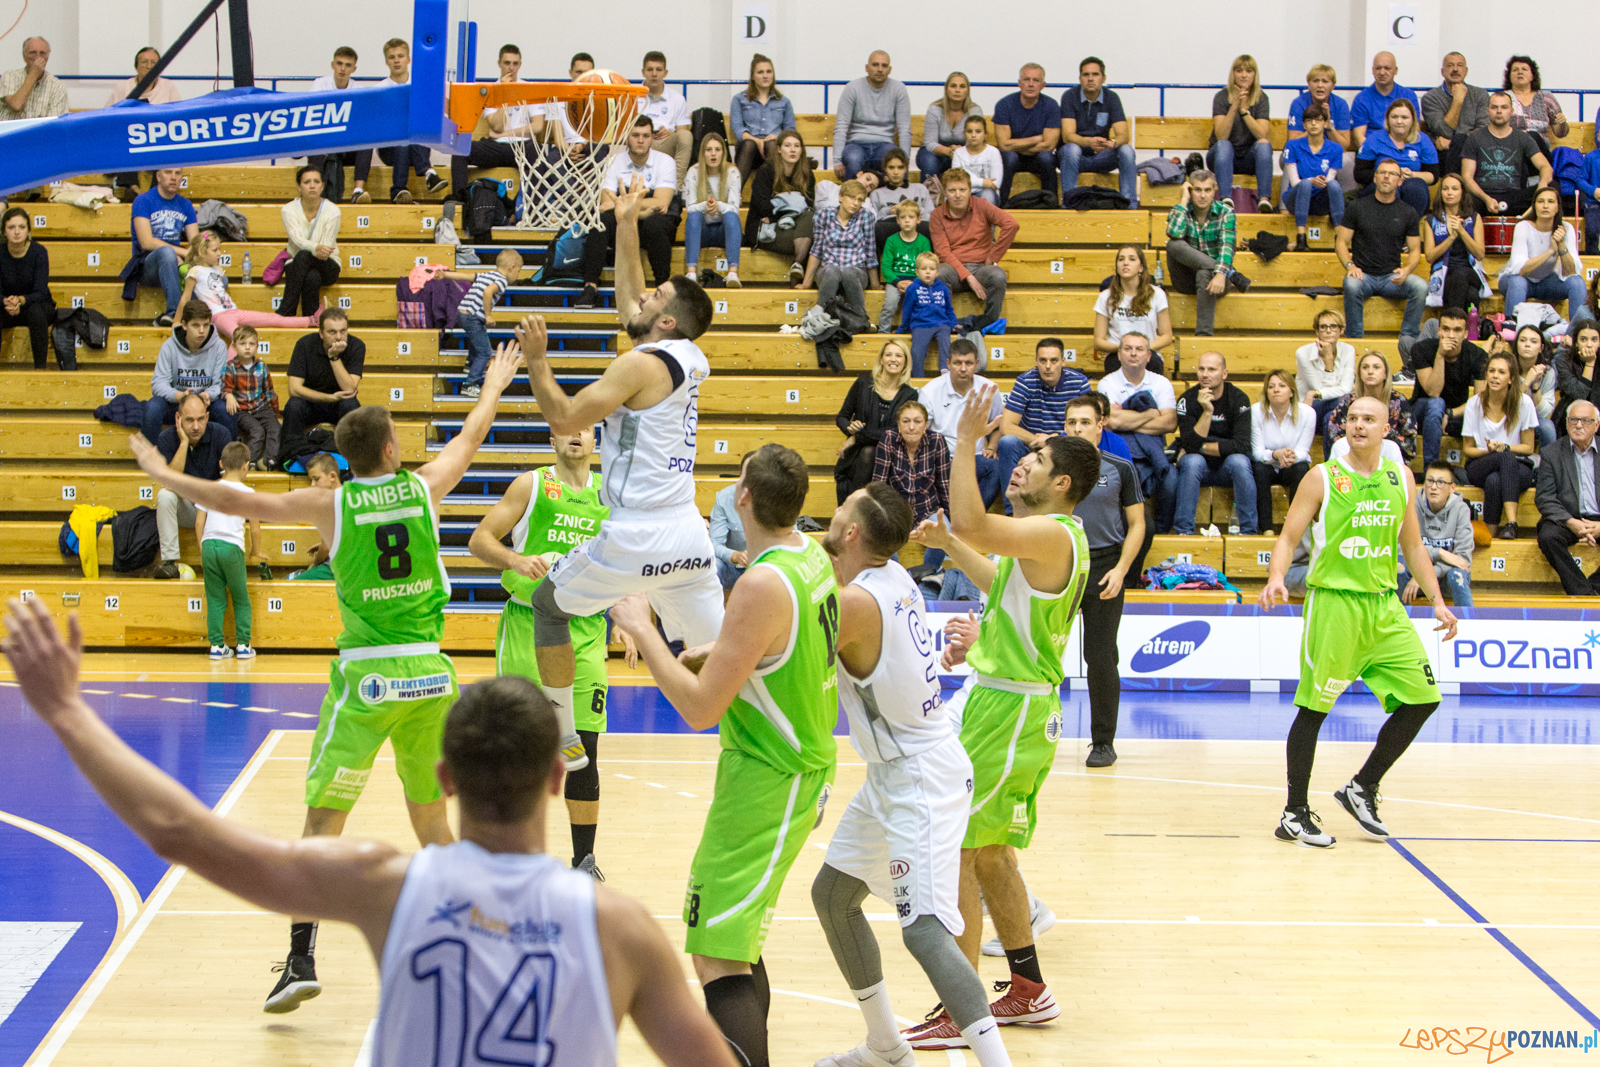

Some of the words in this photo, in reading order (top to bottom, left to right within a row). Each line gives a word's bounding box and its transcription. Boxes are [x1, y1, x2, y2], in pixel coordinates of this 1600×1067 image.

[745, 15, 766, 39] D
[1392, 15, 1414, 40] C
[127, 115, 228, 145] SPORT
[230, 100, 353, 141] SYSTEM
[359, 218, 368, 226] 10
[1310, 229, 1319, 237] 14
[1054, 263, 1060, 271] 2
[340, 299, 350, 307] 10
[719, 303, 724, 311] 7
[789, 303, 794, 311] 6
[260, 343, 268, 351] 11
[402, 344, 407, 352] 9
[995, 349, 1000, 358] 3
[1067, 351, 1072, 359] 2
[177, 368, 206, 377] PYRA
[105, 388, 115, 396] 13
[395, 390, 400, 398] 9
[790, 392, 796, 400] 6
[81, 436, 91, 445] 13
[719, 442, 724, 451] 7
[1386, 470, 1399, 486] 9
[64, 488, 75, 497] 13
[141, 488, 152, 497] 12
[346, 481, 425, 509] UNIBEN
[1355, 500, 1391, 513] ZNICZ
[553, 513, 595, 532] ZNICZ
[1352, 515, 1396, 528] BASKET
[547, 529, 596, 546] BASKE
[283, 542, 295, 551] 10
[375, 523, 412, 580] 8
[1259, 553, 1270, 562] 16
[641, 557, 711, 577] BIOFARM
[1493, 560, 1504, 568] 13
[362, 578, 433, 602] PRUSZKÓW
[107, 599, 118, 607] 12
[190, 600, 200, 609] 11
[270, 600, 281, 609] 10
[1142, 640, 1195, 655] atrem
[1423, 664, 1435, 685] 9
[390, 674, 450, 690] ELEKTROBUD
[398, 686, 446, 698] INVESTMENT
[591, 689, 605, 714] 6
[411, 938, 558, 1067] 14
